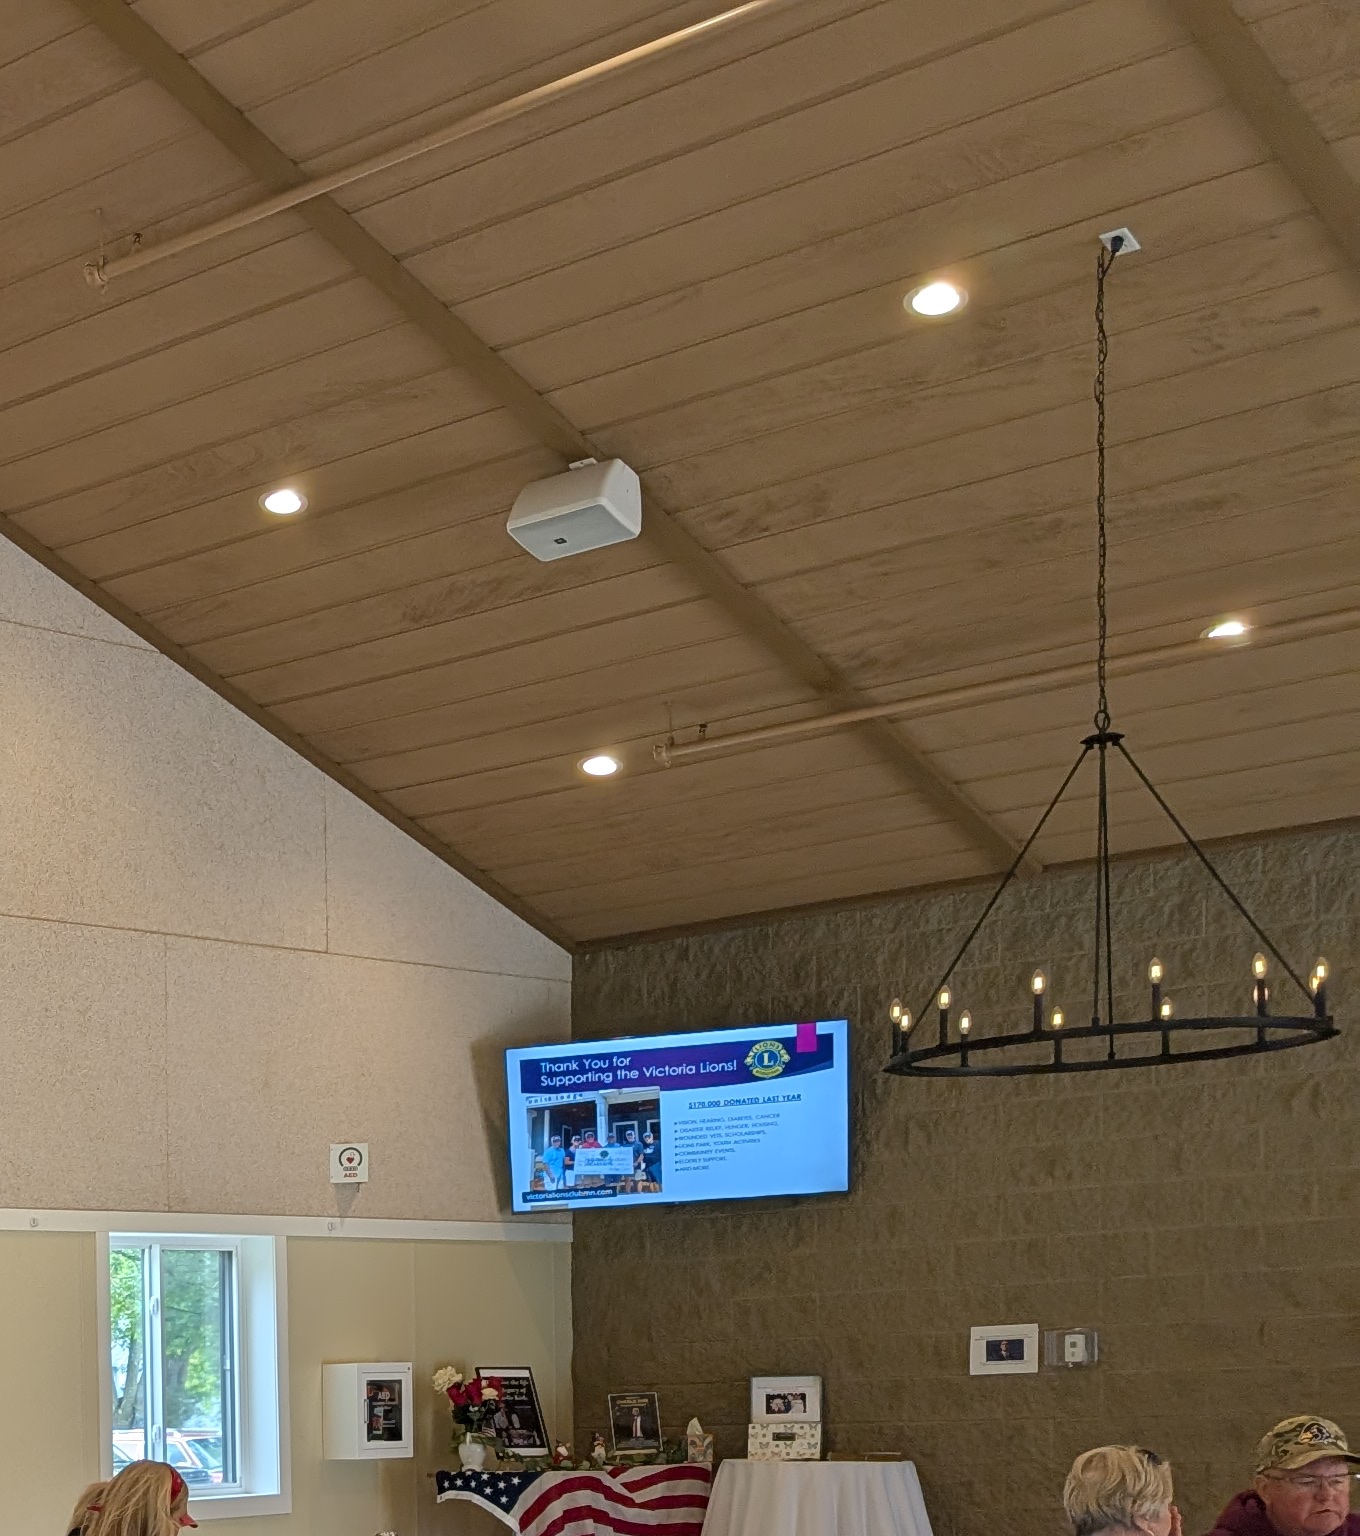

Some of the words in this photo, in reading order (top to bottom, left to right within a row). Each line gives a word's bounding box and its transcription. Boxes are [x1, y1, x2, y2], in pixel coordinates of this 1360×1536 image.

[540, 1059, 580, 1074] Thank
[583, 1057, 609, 1070] You
[612, 1055, 632, 1067] for
[763, 1051, 775, 1066] L
[540, 1070, 613, 1087] Supporting
[616, 1068, 639, 1081] the
[642, 1063, 696, 1078] Victoria
[700, 1059, 738, 1074] Lions!
[723, 1096, 760, 1107] DONATED
[762, 1095, 780, 1104] LAST
[782, 1093, 802, 1102] YEAR
